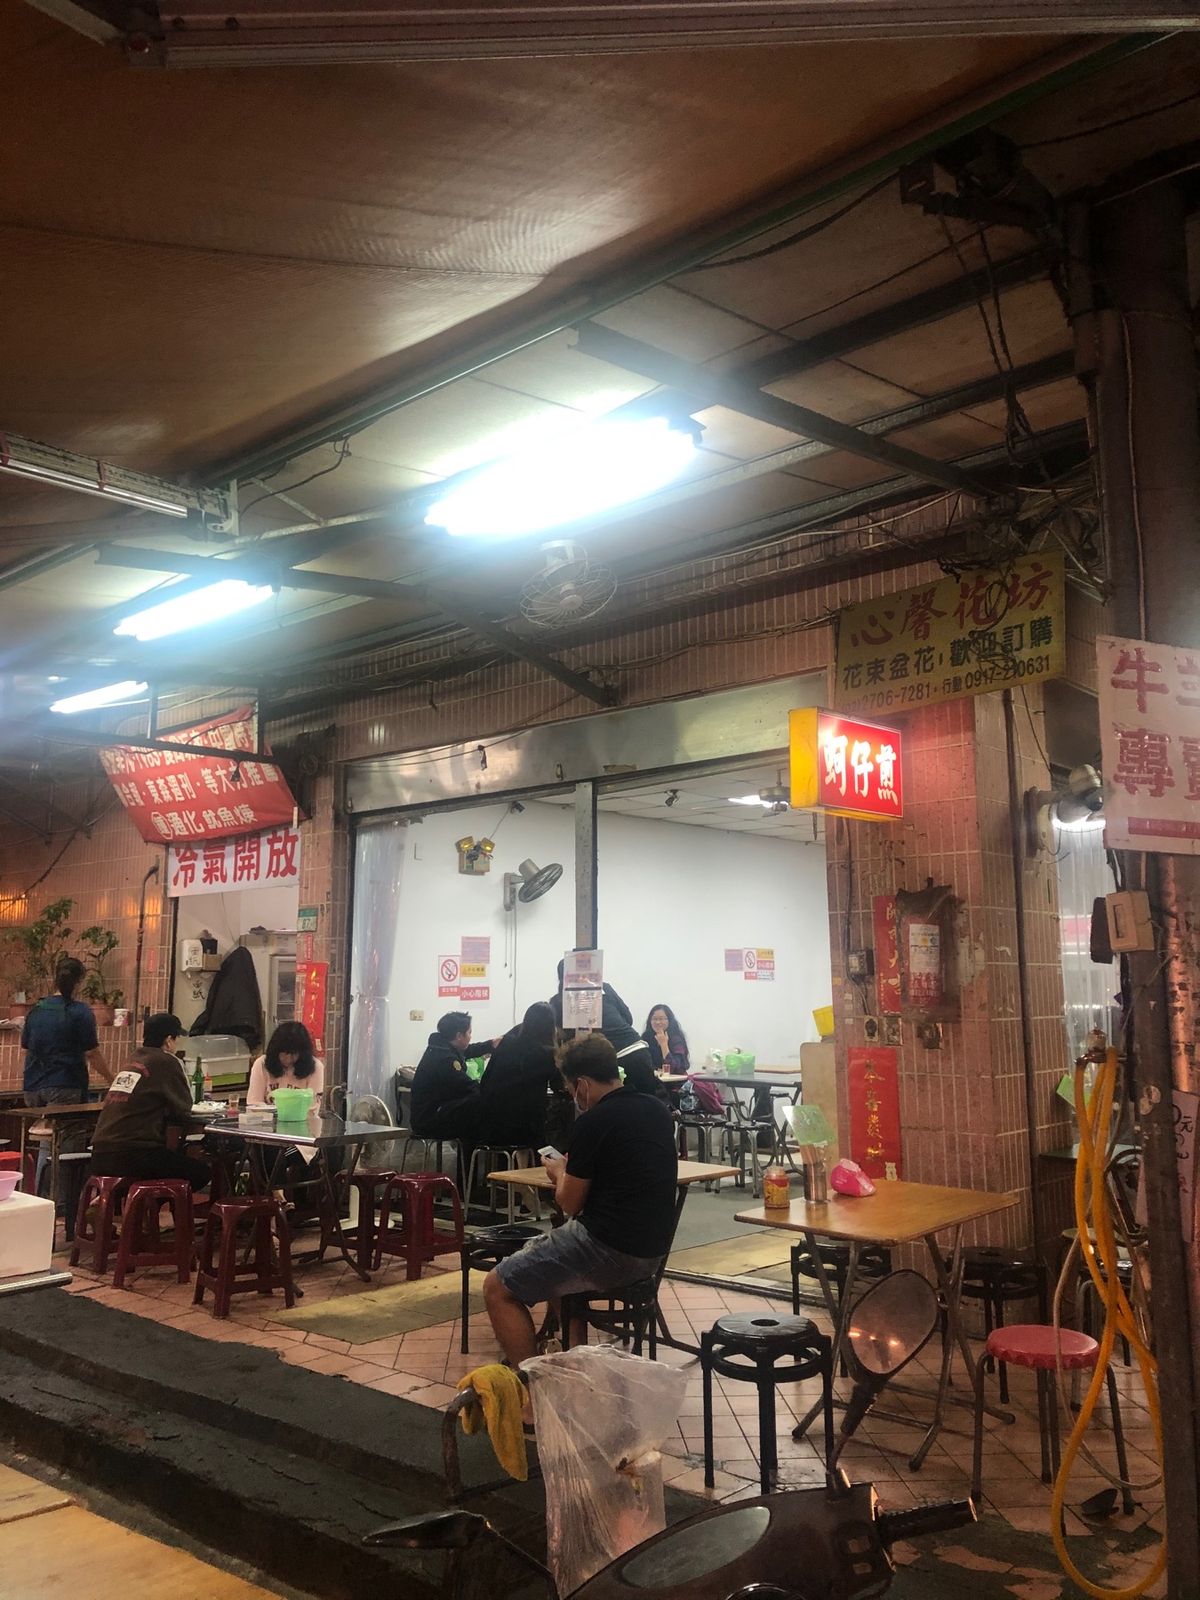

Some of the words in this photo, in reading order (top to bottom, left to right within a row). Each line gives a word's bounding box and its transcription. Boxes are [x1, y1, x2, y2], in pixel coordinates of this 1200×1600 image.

[823, 728, 899, 806] 蚵仔煎
[172, 827, 299, 889] 冷氣開放
